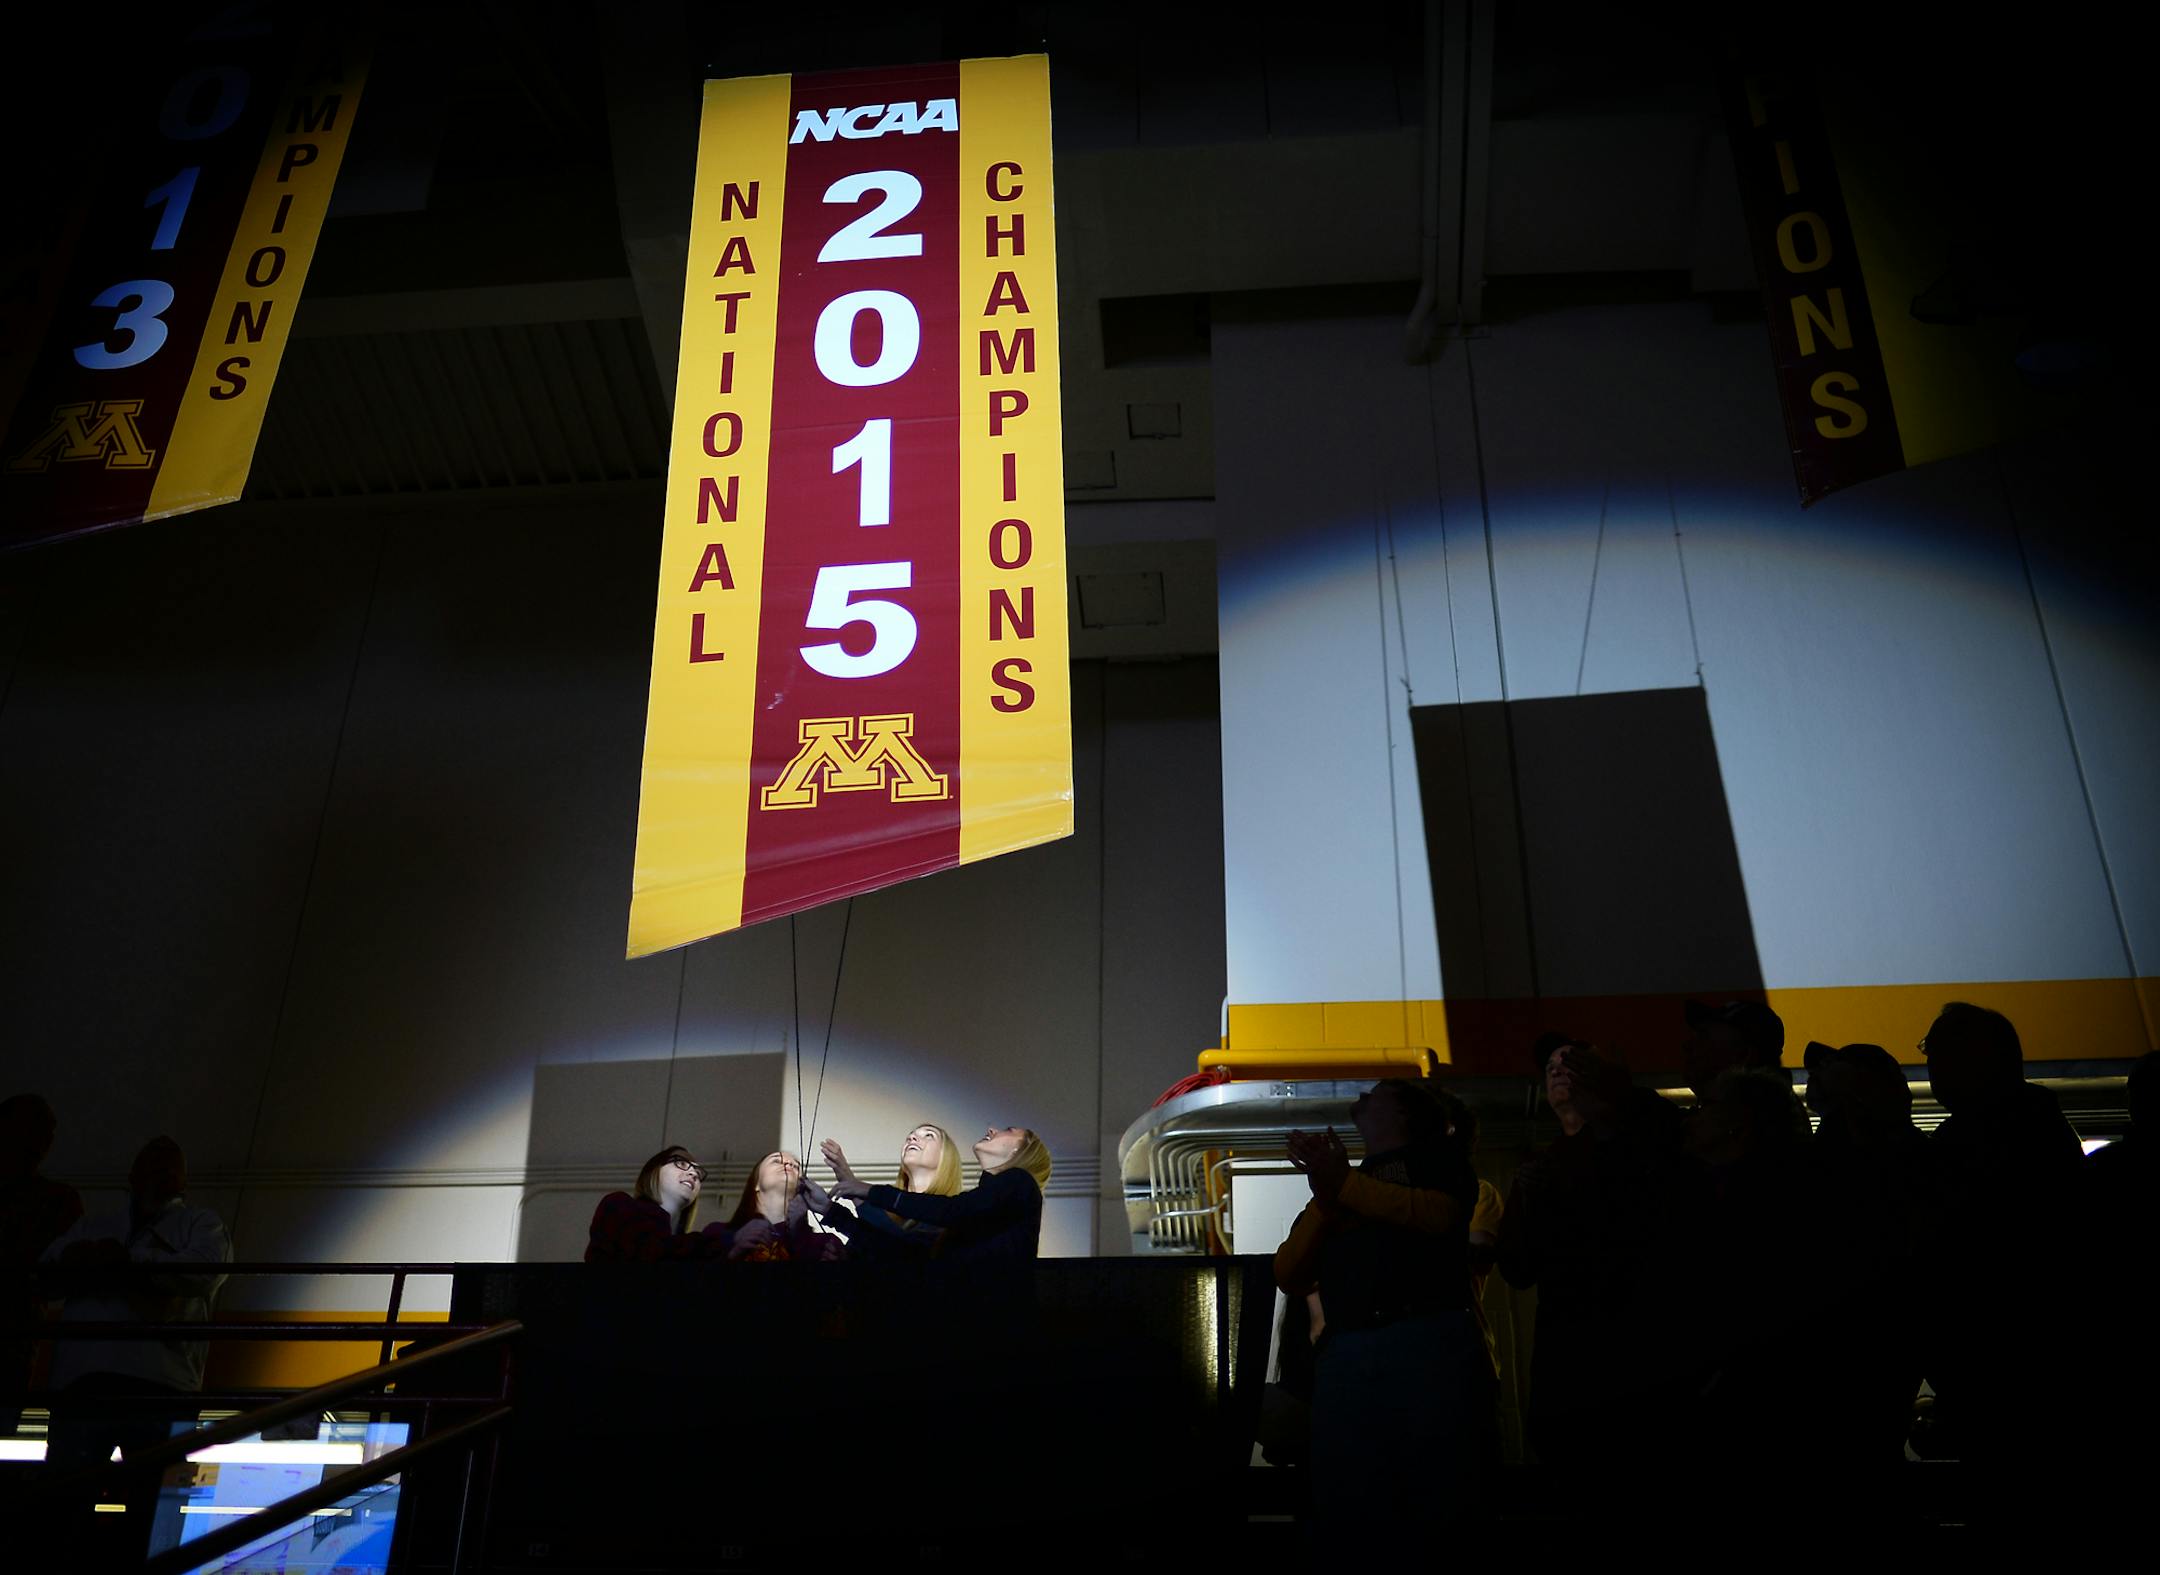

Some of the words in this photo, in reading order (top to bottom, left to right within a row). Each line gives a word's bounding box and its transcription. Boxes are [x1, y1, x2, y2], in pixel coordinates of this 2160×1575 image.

[790, 98, 958, 143] NCAA
[688, 182, 759, 664] NATIONAL
[800, 169, 925, 678] 2015
[981, 162, 1036, 713] CHAMPIONS
